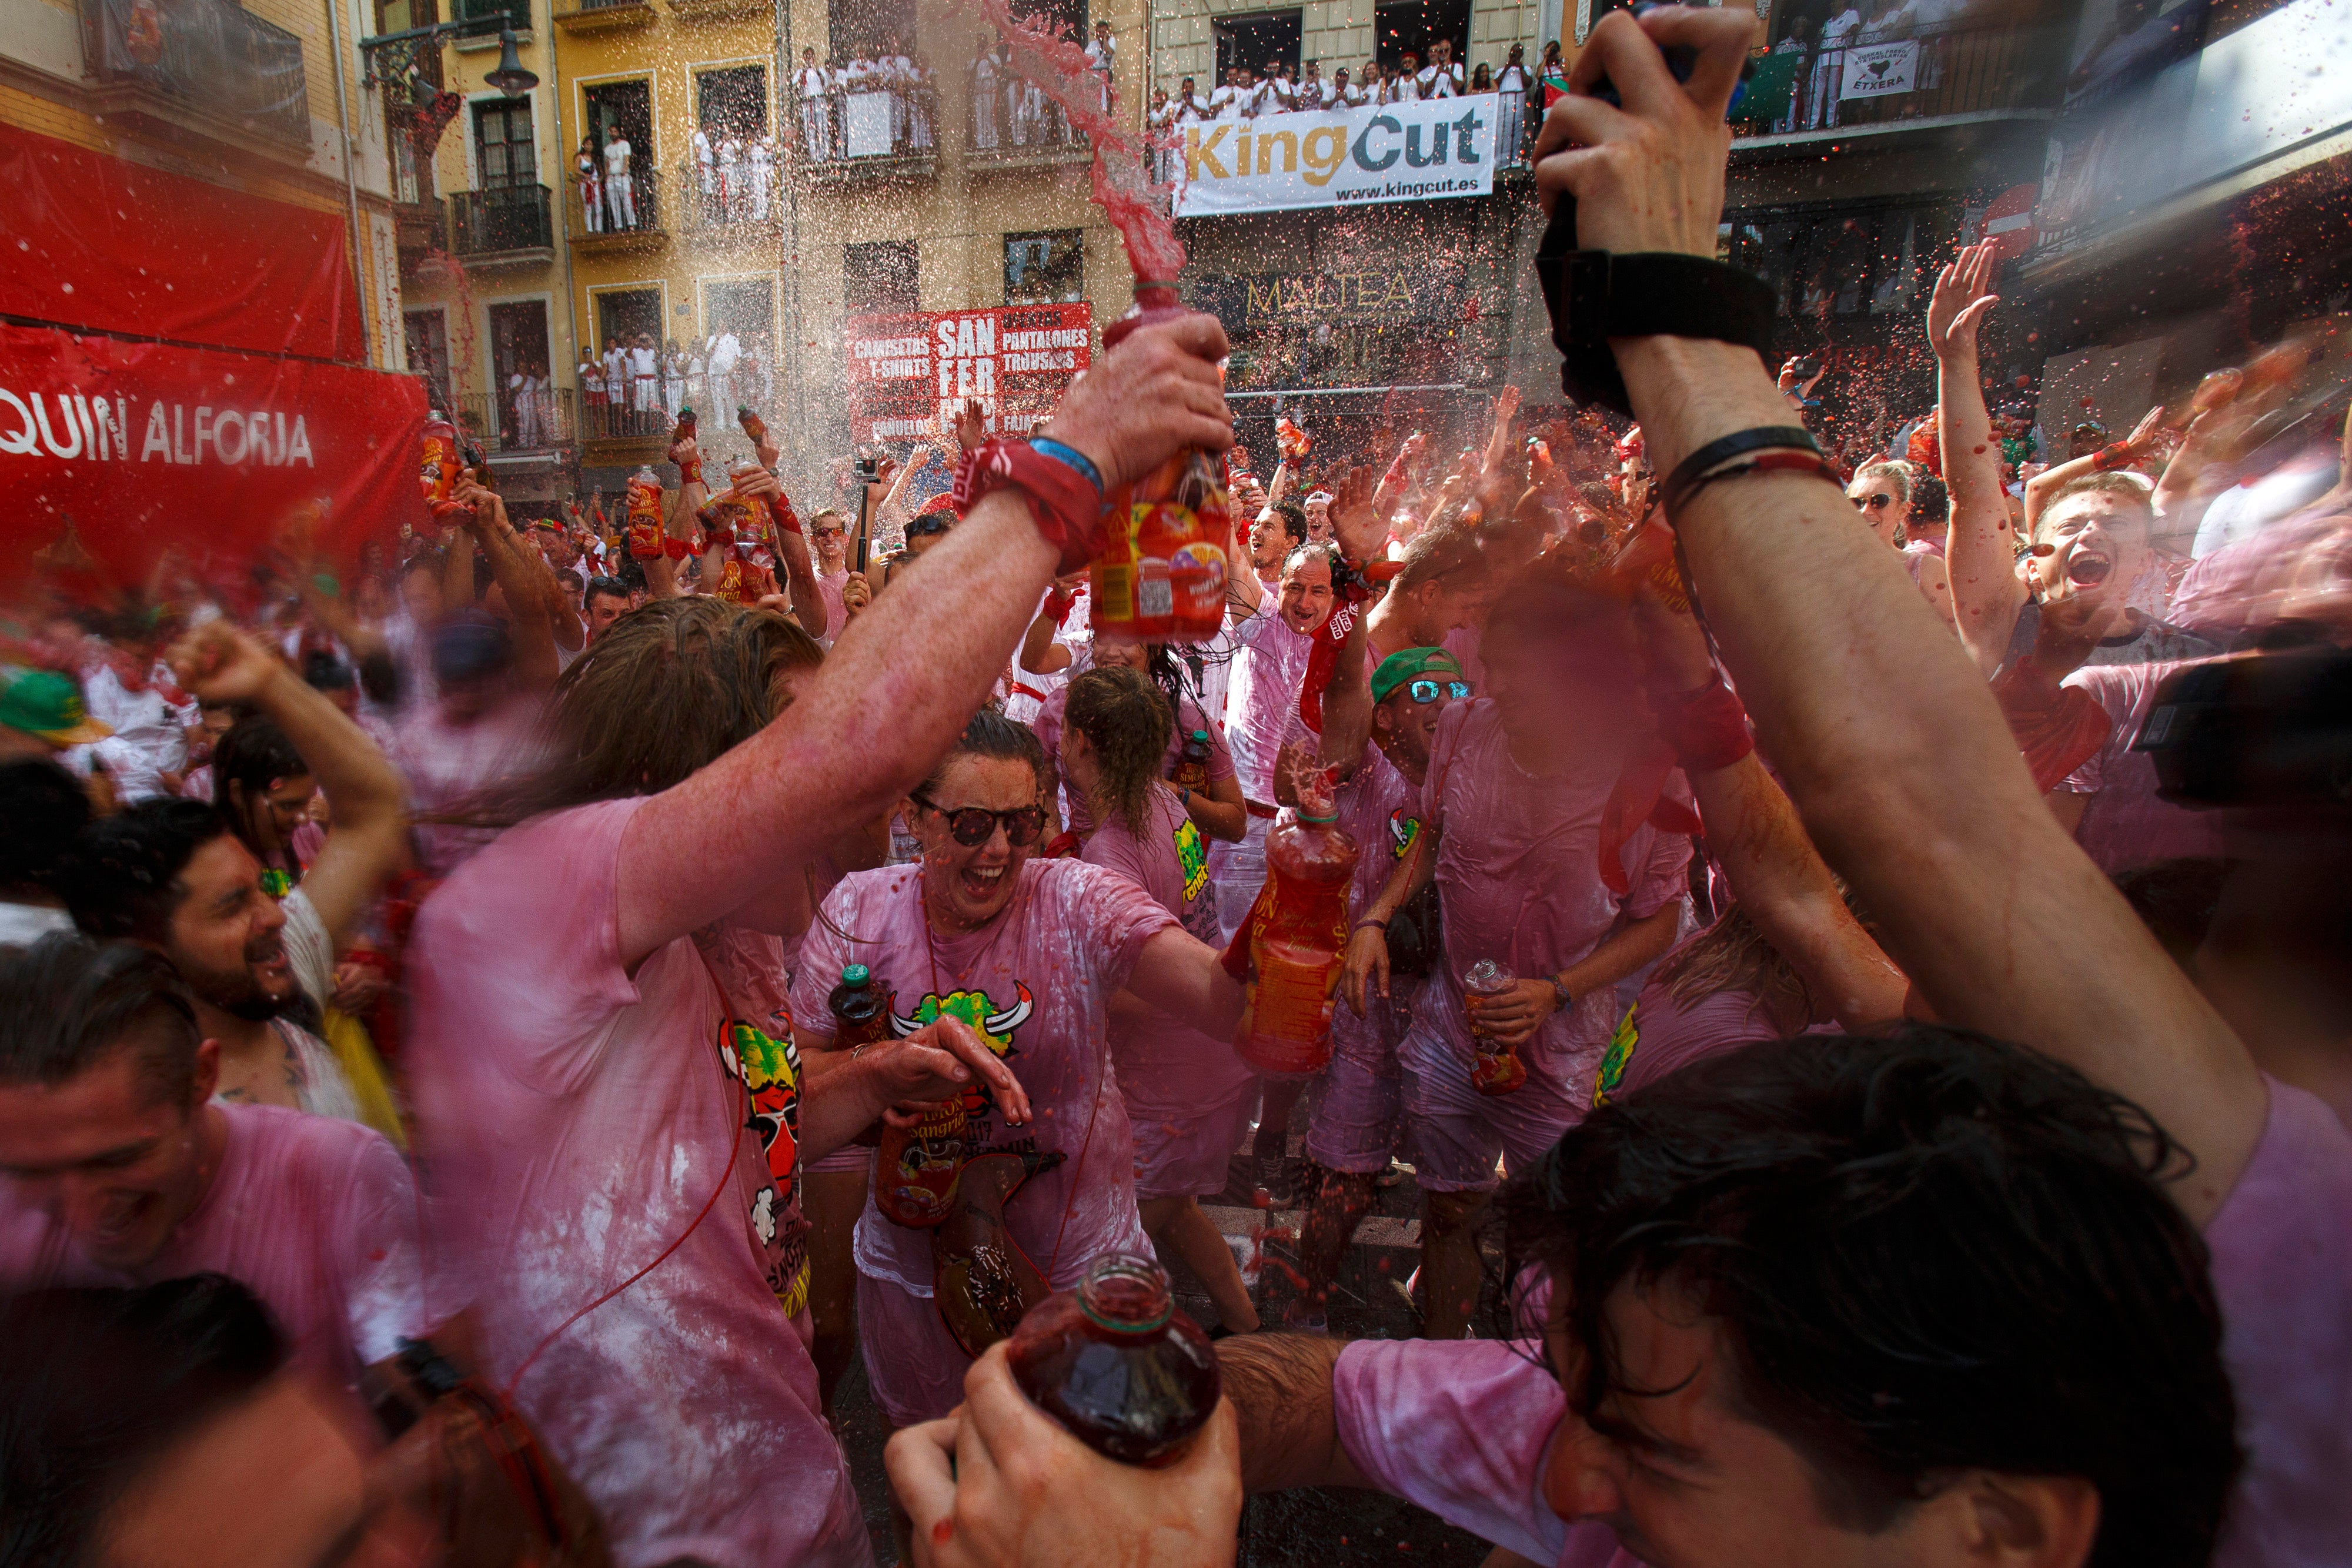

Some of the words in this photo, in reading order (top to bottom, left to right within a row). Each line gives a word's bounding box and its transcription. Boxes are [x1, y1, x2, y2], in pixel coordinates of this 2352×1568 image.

[1858, 51, 1883, 60] EUSKAL
[1853, 76, 1905, 91] ETXERA
[1186, 107, 1483, 187] KingCut
[1336, 177, 1479, 202] www.kingcut.es
[1247, 270, 1412, 314] MALTEA
[1003, 310, 1062, 328] OFERTAS
[855, 337, 930, 359] CAMISETAS
[937, 317, 995, 358] SAN
[1003, 329, 1088, 350] PANTALONES
[869, 357, 930, 378] T-SHIRTS
[939, 357, 995, 396] FER
[141, 400, 315, 468] ALFORJA
